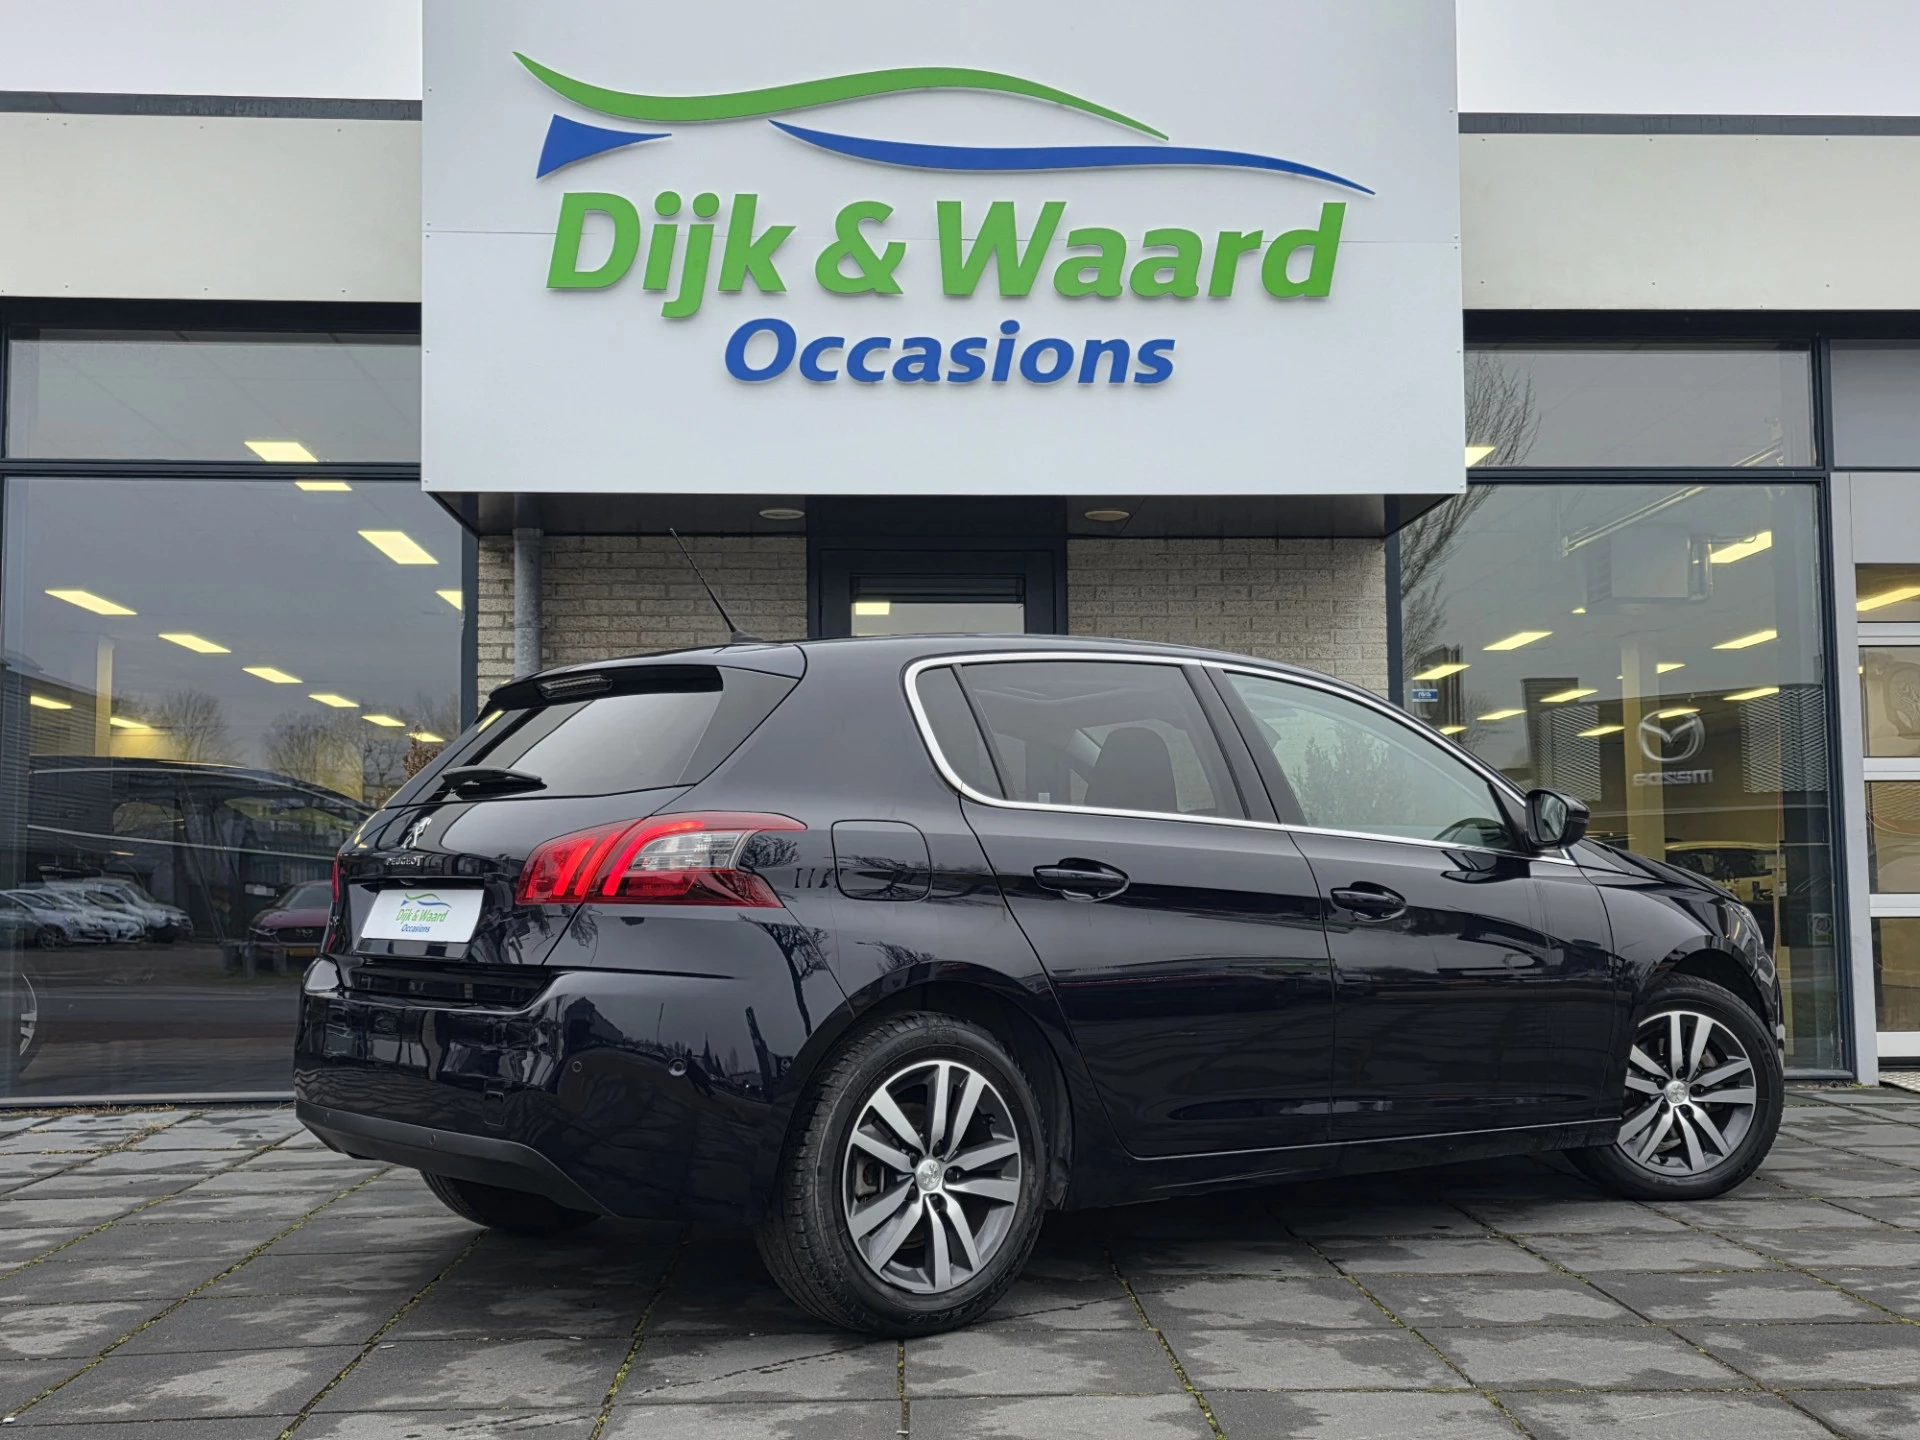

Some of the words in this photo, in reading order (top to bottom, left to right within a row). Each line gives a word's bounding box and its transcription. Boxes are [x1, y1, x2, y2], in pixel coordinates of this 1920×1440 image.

[546, 192, 794, 318] Dijk
[814, 200, 907, 294] &
[935, 200, 1347, 299] Waard
[724, 317, 1176, 386] Occasions
[385, 855, 424, 866] PEUGEOT
[395, 908, 412, 924] Dijk
[418, 909, 449, 922] Waard
[400, 923, 431, 933] Occasions
